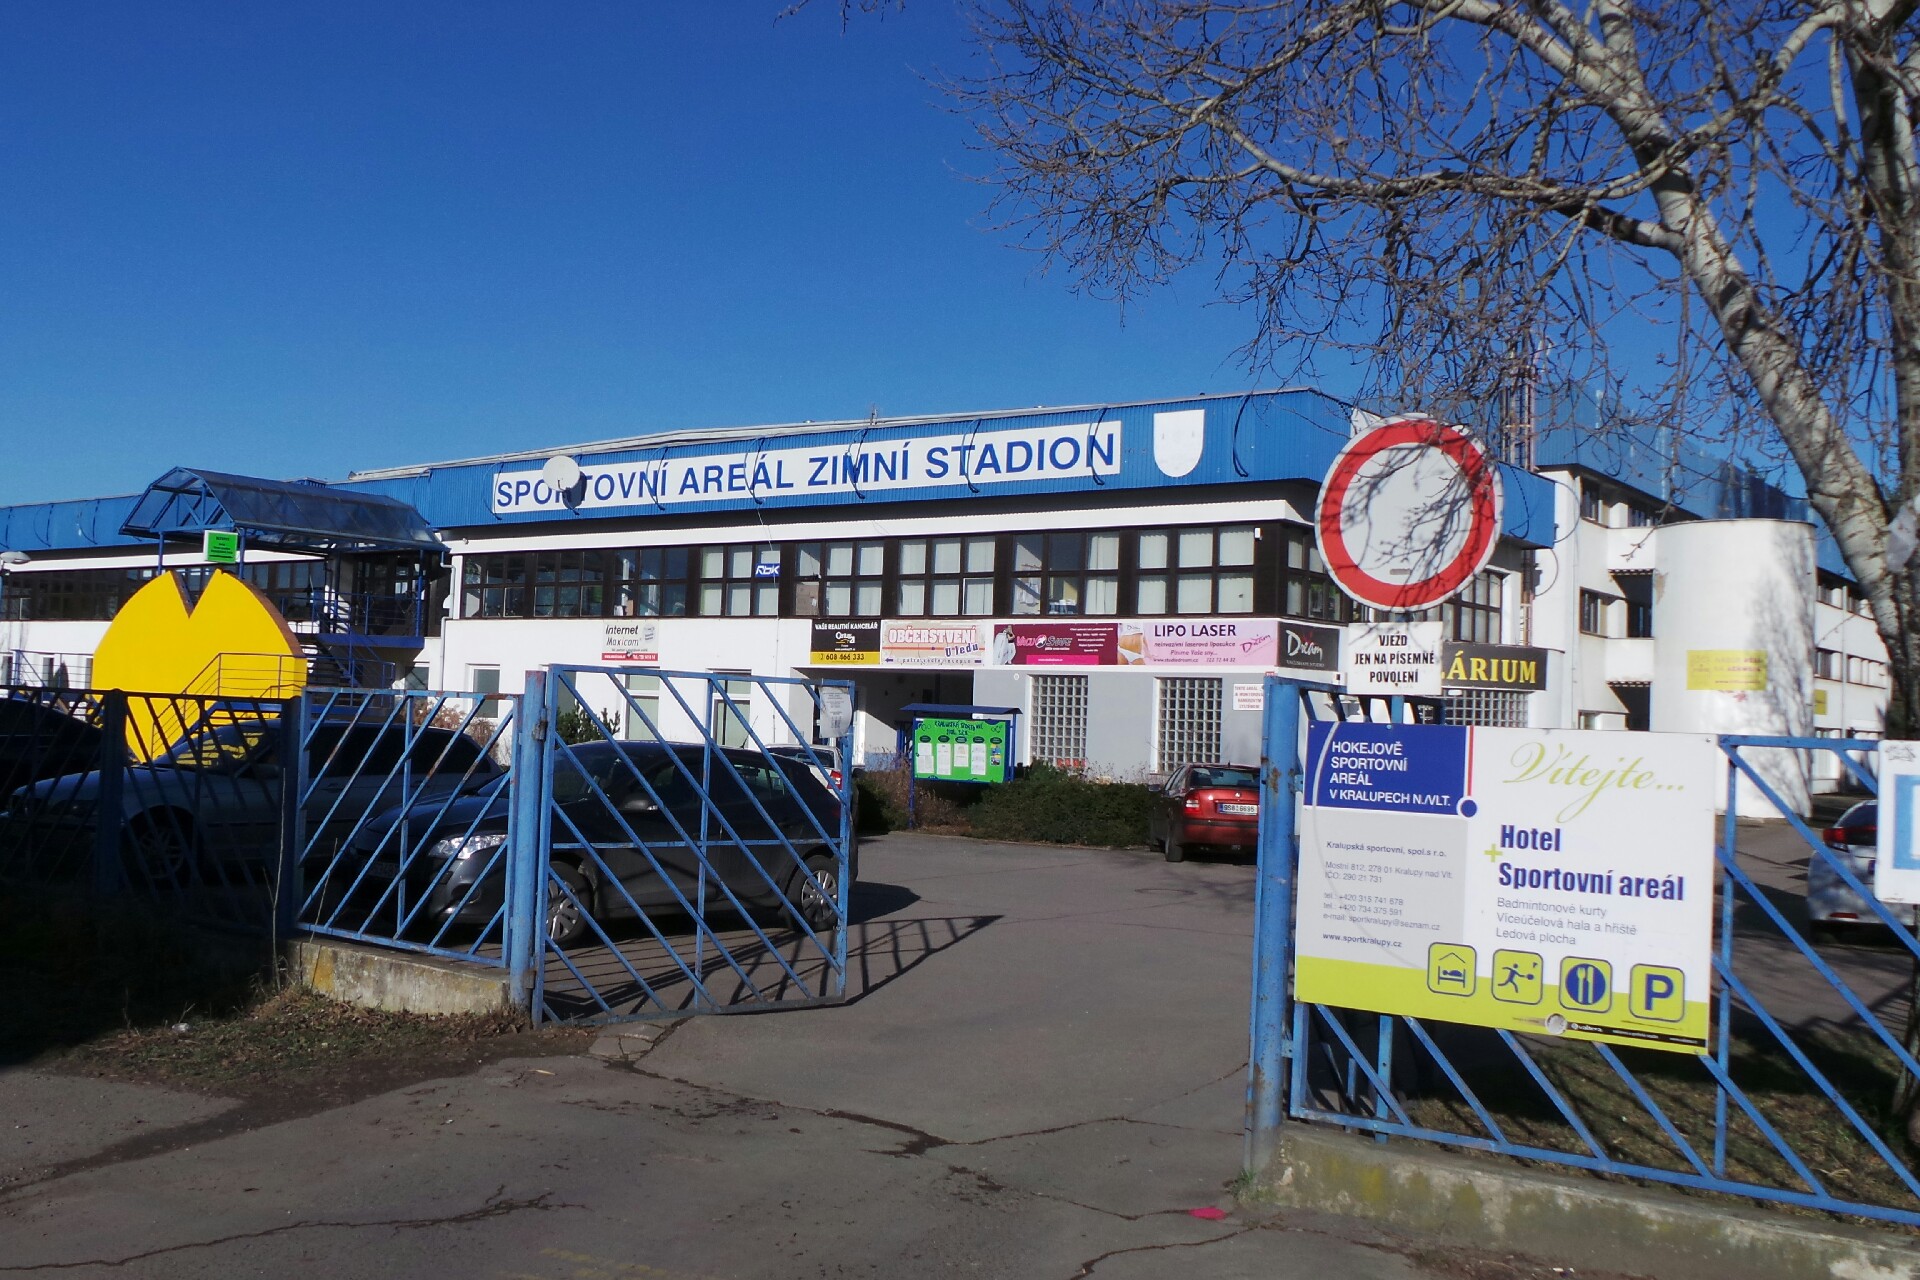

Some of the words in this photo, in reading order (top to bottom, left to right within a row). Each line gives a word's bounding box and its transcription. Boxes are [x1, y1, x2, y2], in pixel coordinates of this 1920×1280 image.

[497, 462, 667, 507] SPOTOVNÍ
[679, 453, 794, 495] AREÁL
[808, 441, 910, 487] ZIMNÍ
[925, 433, 1114, 479] STADION
[605, 625, 639, 635] Internet
[889, 625, 977, 644] OBČERSTVENÍ
[1154, 625, 1187, 637] LIPO
[1191, 625, 1237, 636] LASER
[1379, 634, 1408, 647] VJEZD
[1355, 653, 1371, 665] JEN
[1374, 653, 1386, 665] NA
[1389, 650, 1435, 665] PÍSEMNÉ
[1441, 650, 1537, 684] ÁRIUM
[1369, 668, 1419, 683] POVOLENÍ
[1331, 757, 1408, 771] SPORTOVNÍ
[1329, 771, 1373, 785] AREÁL
[1502, 741, 1685, 824] Vítejte...
[1329, 789, 1337, 799] V
[1340, 789, 1411, 804] KRALUPECH
[1500, 824, 1561, 851] Hotel
[1326, 841, 1365, 851] Kralupská
[1369, 875, 1382, 883] 731
[1395, 867, 1423, 878] Kralupy
[1425, 869, 1439, 878] nad
[1498, 862, 1614, 895] Sportovní
[1619, 874, 1685, 901] areál
[1497, 897, 1576, 914] Badmintonové
[1579, 901, 1607, 918] kurty
[1497, 912, 1563, 929] Víceúčelová
[1567, 919, 1590, 931] hala
[1594, 924, 1601, 932] a
[1323, 933, 1403, 948] www.sportkralupy.cz
[1496, 927, 1536, 941] Ledová
[1539, 932, 1576, 945] plocha
